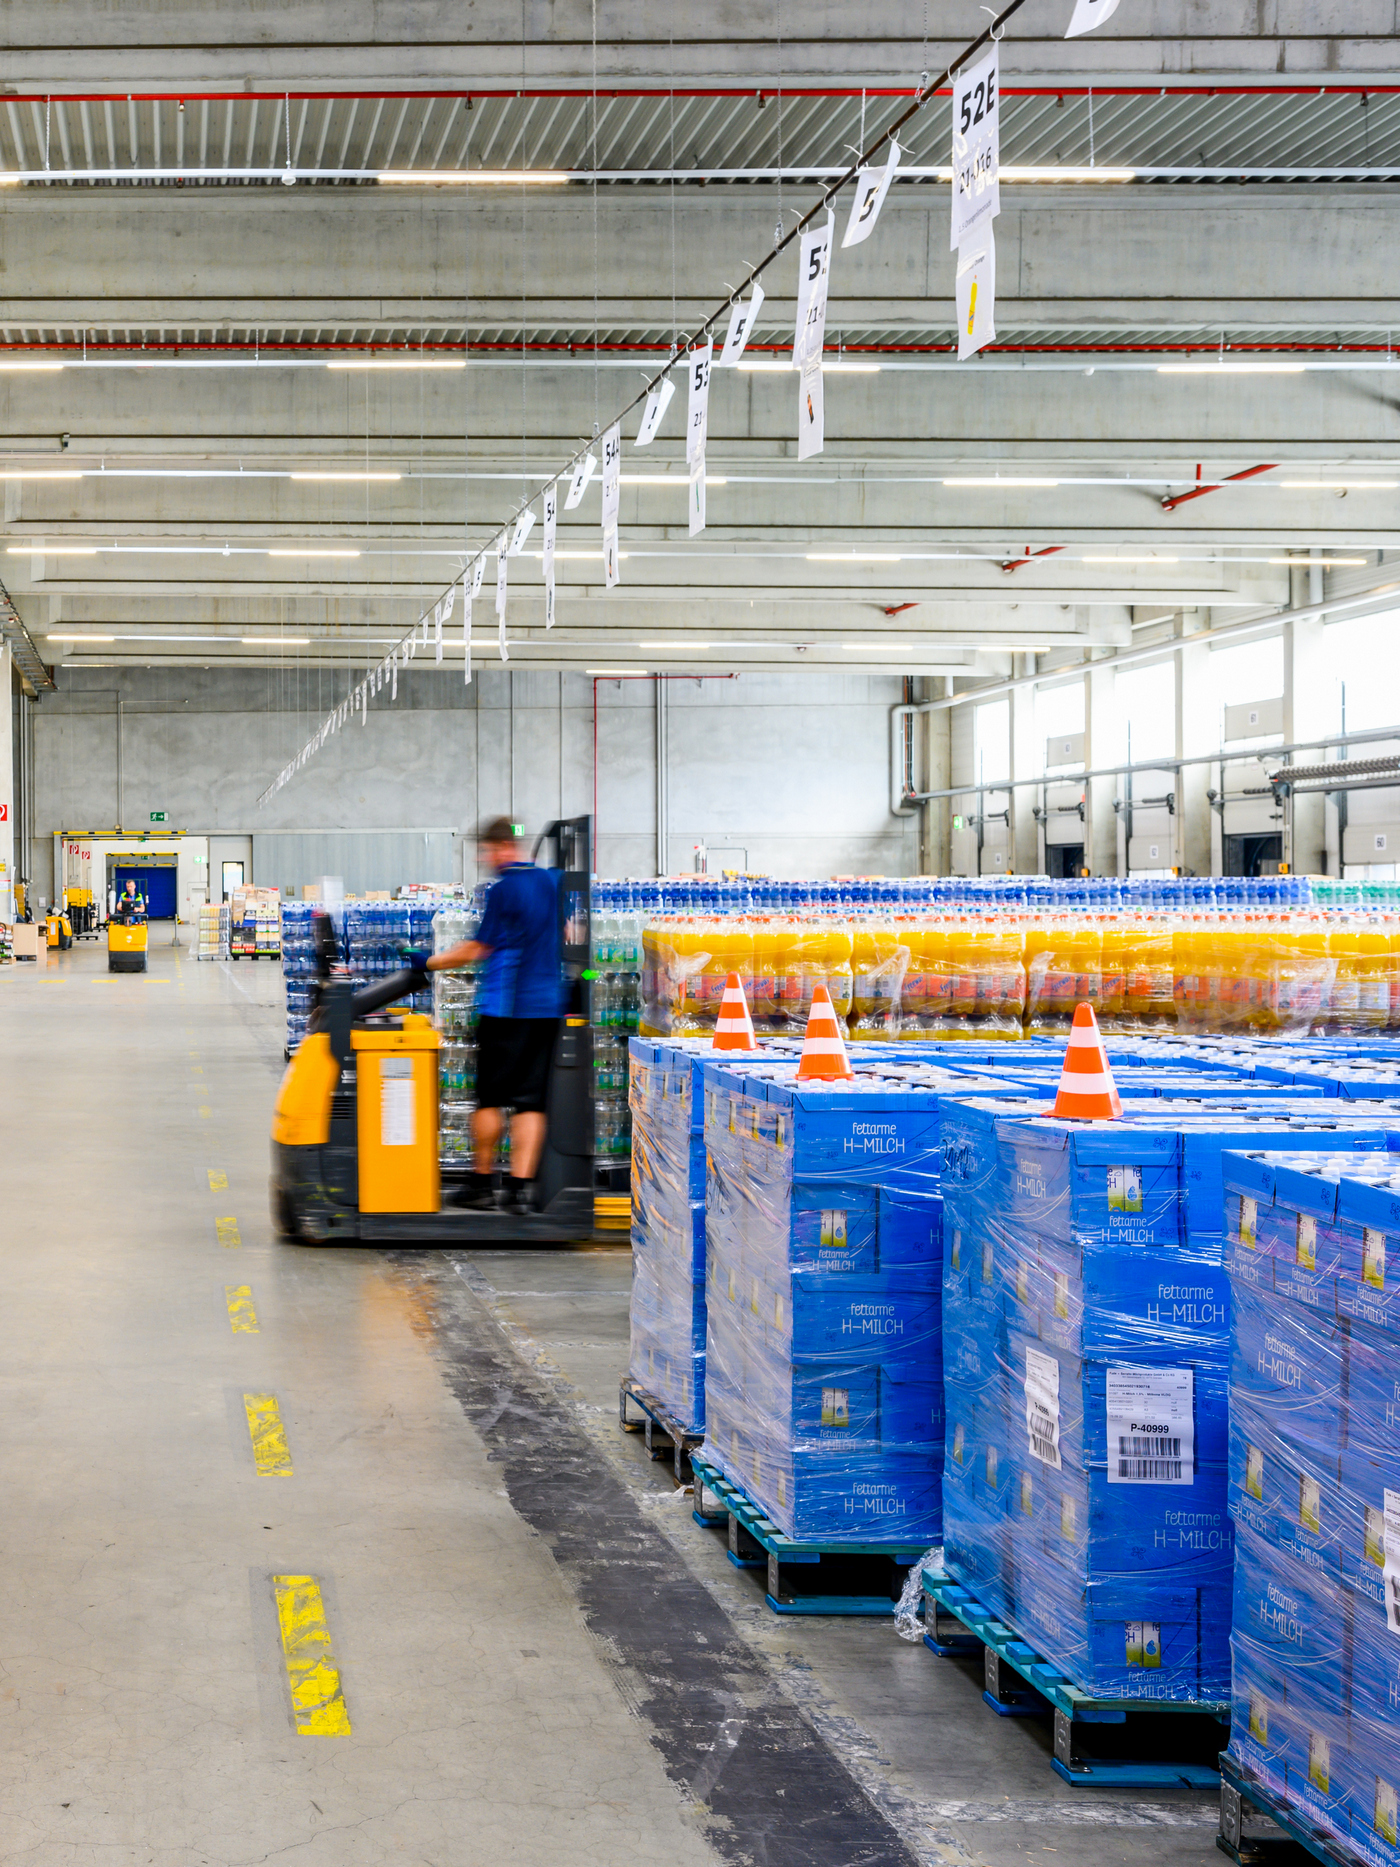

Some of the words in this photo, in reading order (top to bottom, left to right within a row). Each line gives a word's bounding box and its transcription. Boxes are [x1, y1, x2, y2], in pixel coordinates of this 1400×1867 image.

[961, 68, 995, 135] 52E
[852, 1122, 896, 1135] fettarme
[843, 1138, 905, 1153] H-MILCH
[1017, 1176, 1046, 1198] H-MILCH
[1109, 1215, 1147, 1228] fettarme
[1101, 1229, 1154, 1243] H-MILCH
[819, 1250, 850, 1259] fettarme
[812, 1260, 855, 1271] H-MILCH
[1230, 1260, 1259, 1284] H-MILCH
[1158, 1284, 1214, 1300] fettarme
[1287, 1282, 1318, 1306] H-MILCH
[850, 1303, 894, 1316] fettarme
[1147, 1303, 1224, 1323] H-MILCH
[1352, 1300, 1388, 1327] H-MILCH
[842, 1319, 904, 1335] H-MILCH
[1265, 1333, 1296, 1361] fettarme
[1258, 1351, 1301, 1389] H-MILCH
[820, 1429, 851, 1439] fettarme
[1131, 1424, 1169, 1433] P-40999
[852, 1482, 897, 1495] fettarme
[844, 1499, 905, 1514] H-MILCH
[1165, 1510, 1220, 1527] fettarme
[1154, 1529, 1231, 1550] H-MILCH
[1290, 1540, 1324, 1570] H-MILCH
[1355, 1575, 1385, 1604] H-MILC
[1267, 1583, 1298, 1616] fettarme
[1260, 1600, 1303, 1647] H-MILCH
[1128, 1671, 1166, 1683] fettarme
